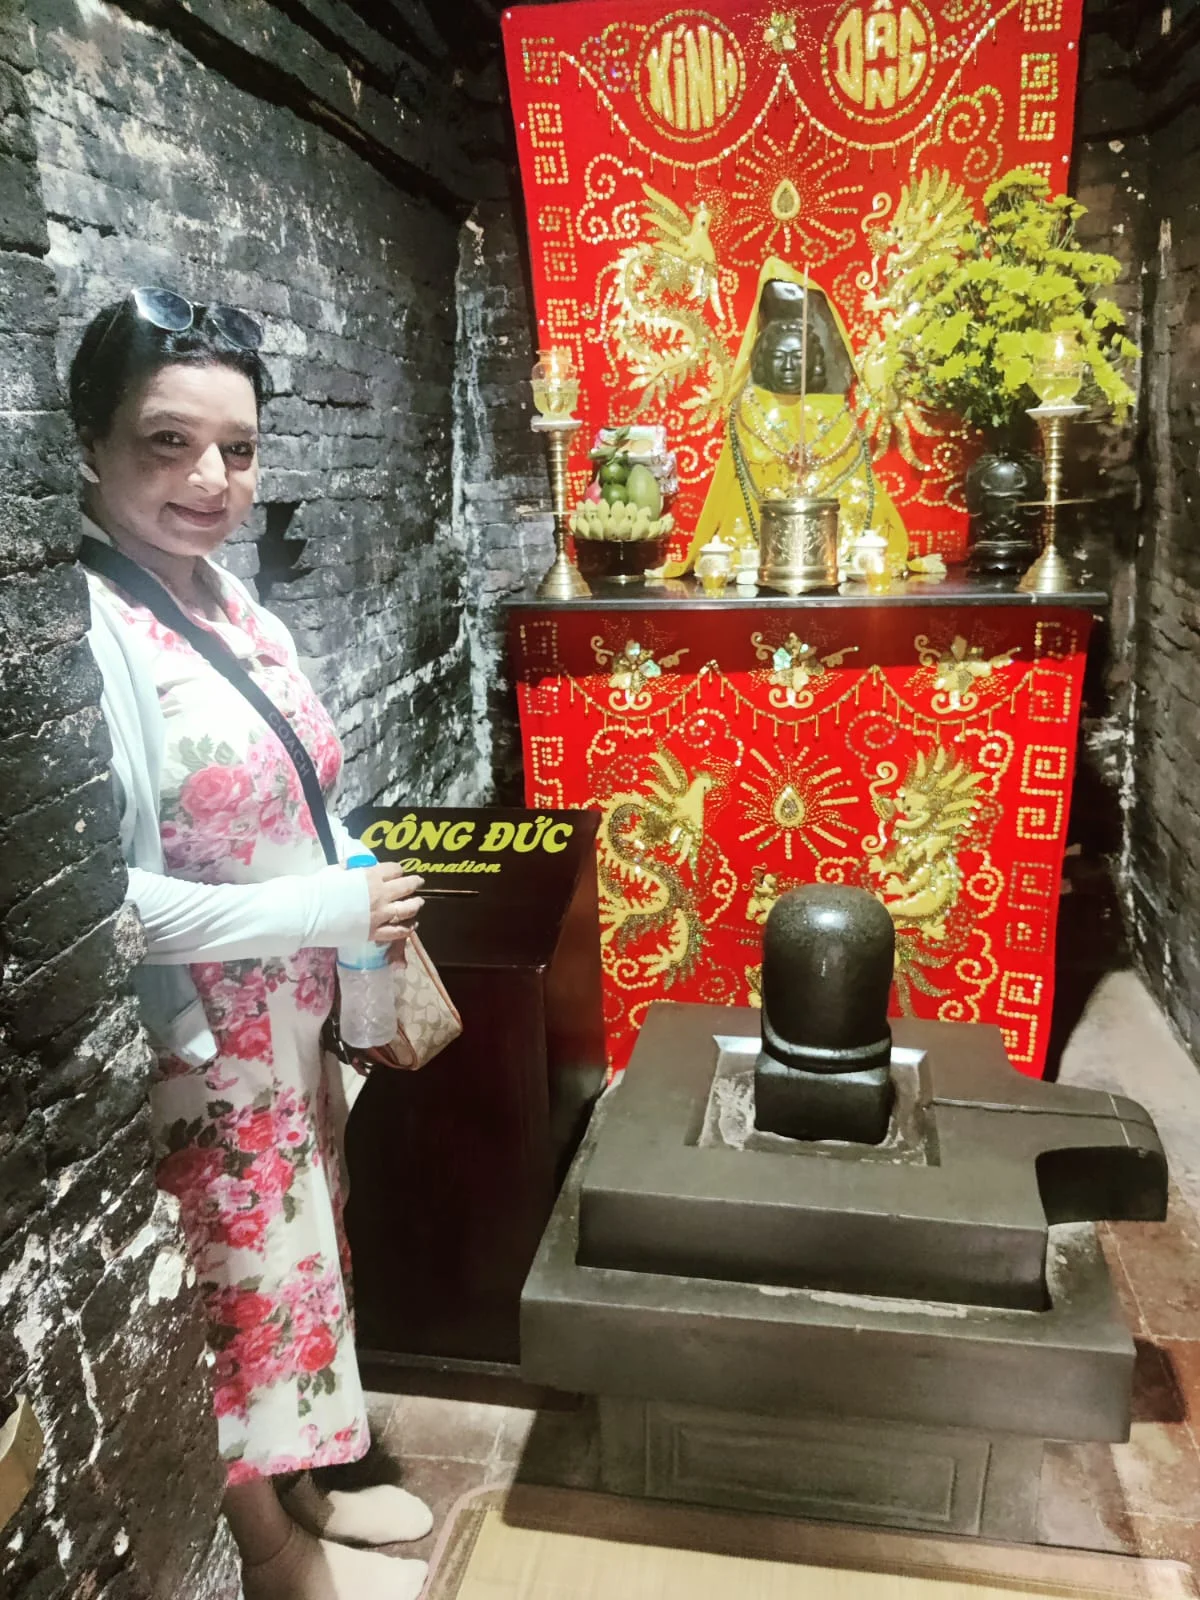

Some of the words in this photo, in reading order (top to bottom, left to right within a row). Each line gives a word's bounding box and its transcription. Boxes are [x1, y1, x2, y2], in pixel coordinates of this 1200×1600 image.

[268, 711, 310, 777] COACH
[360, 812, 476, 851] CÔNG
[478, 815, 573, 853] ĐỨC
[399, 857, 502, 873] Donation
